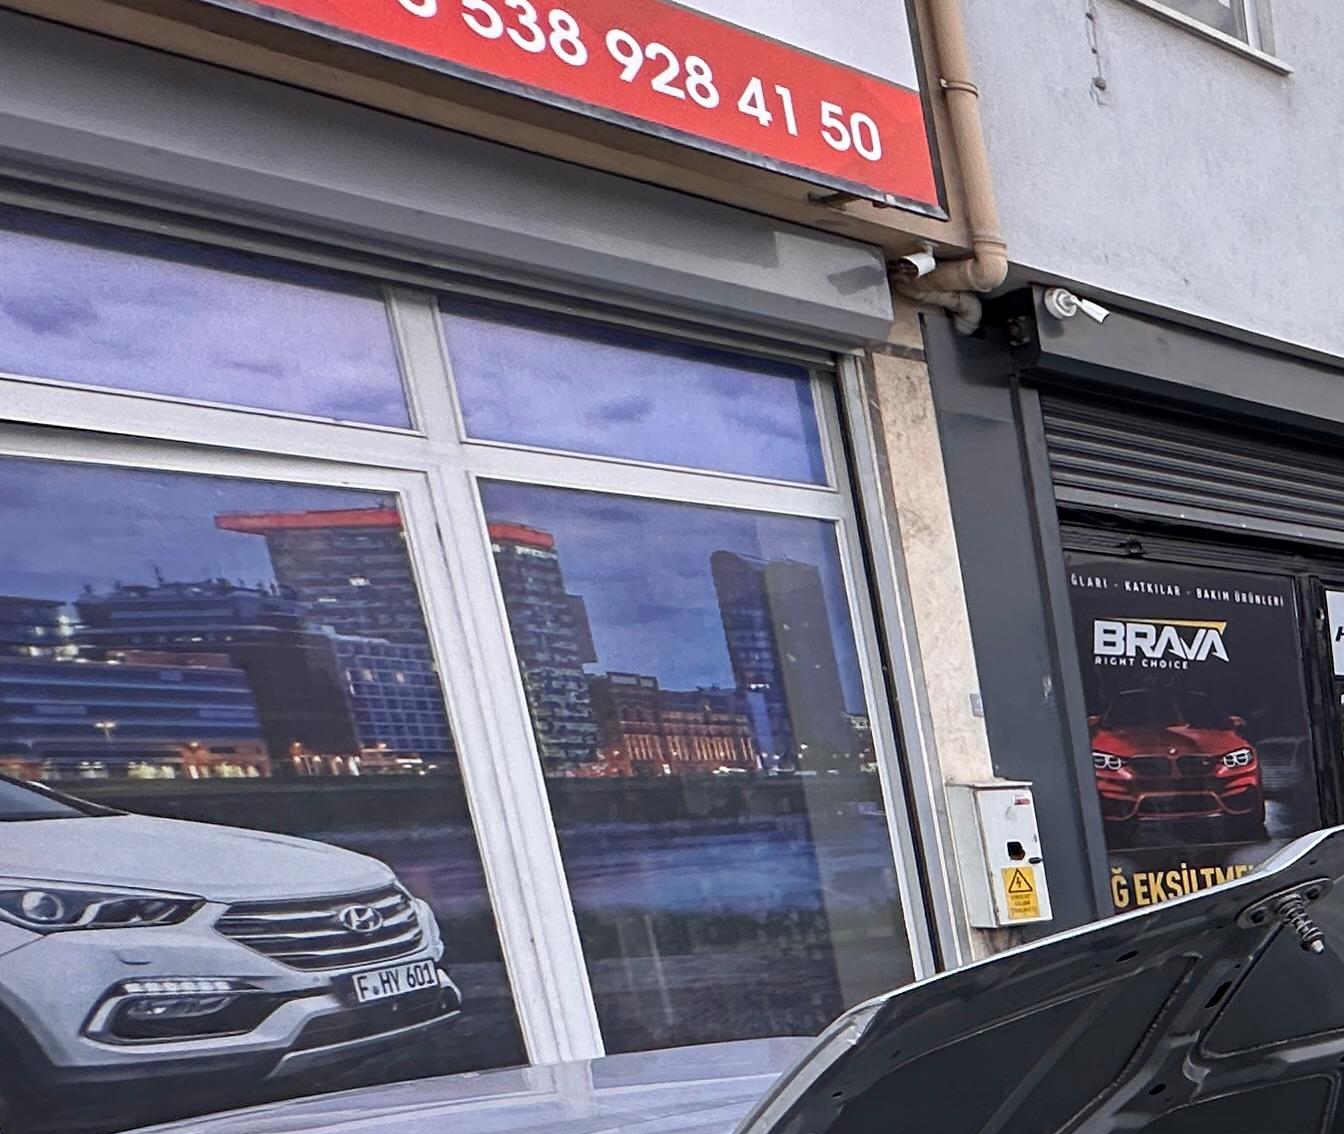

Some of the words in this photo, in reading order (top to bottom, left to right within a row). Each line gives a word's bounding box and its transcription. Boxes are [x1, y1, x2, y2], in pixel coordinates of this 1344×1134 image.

[462, 0, 588, 66] 538
[606, 29, 720, 109] 928
[738, 78, 798, 136] 41
[820, 101, 882, 161] 50
[1124, 580, 1181, 597] KATKILAR
[1195, 587, 1230, 601] BAKIM
[1093, 619, 1230, 663] BRAVA
[1094, 656, 1135, 667] RIGHT
[1141, 658, 1189, 670] CHOICE
[379, 968, 401, 994] HY
[406, 962, 435, 988] 601
